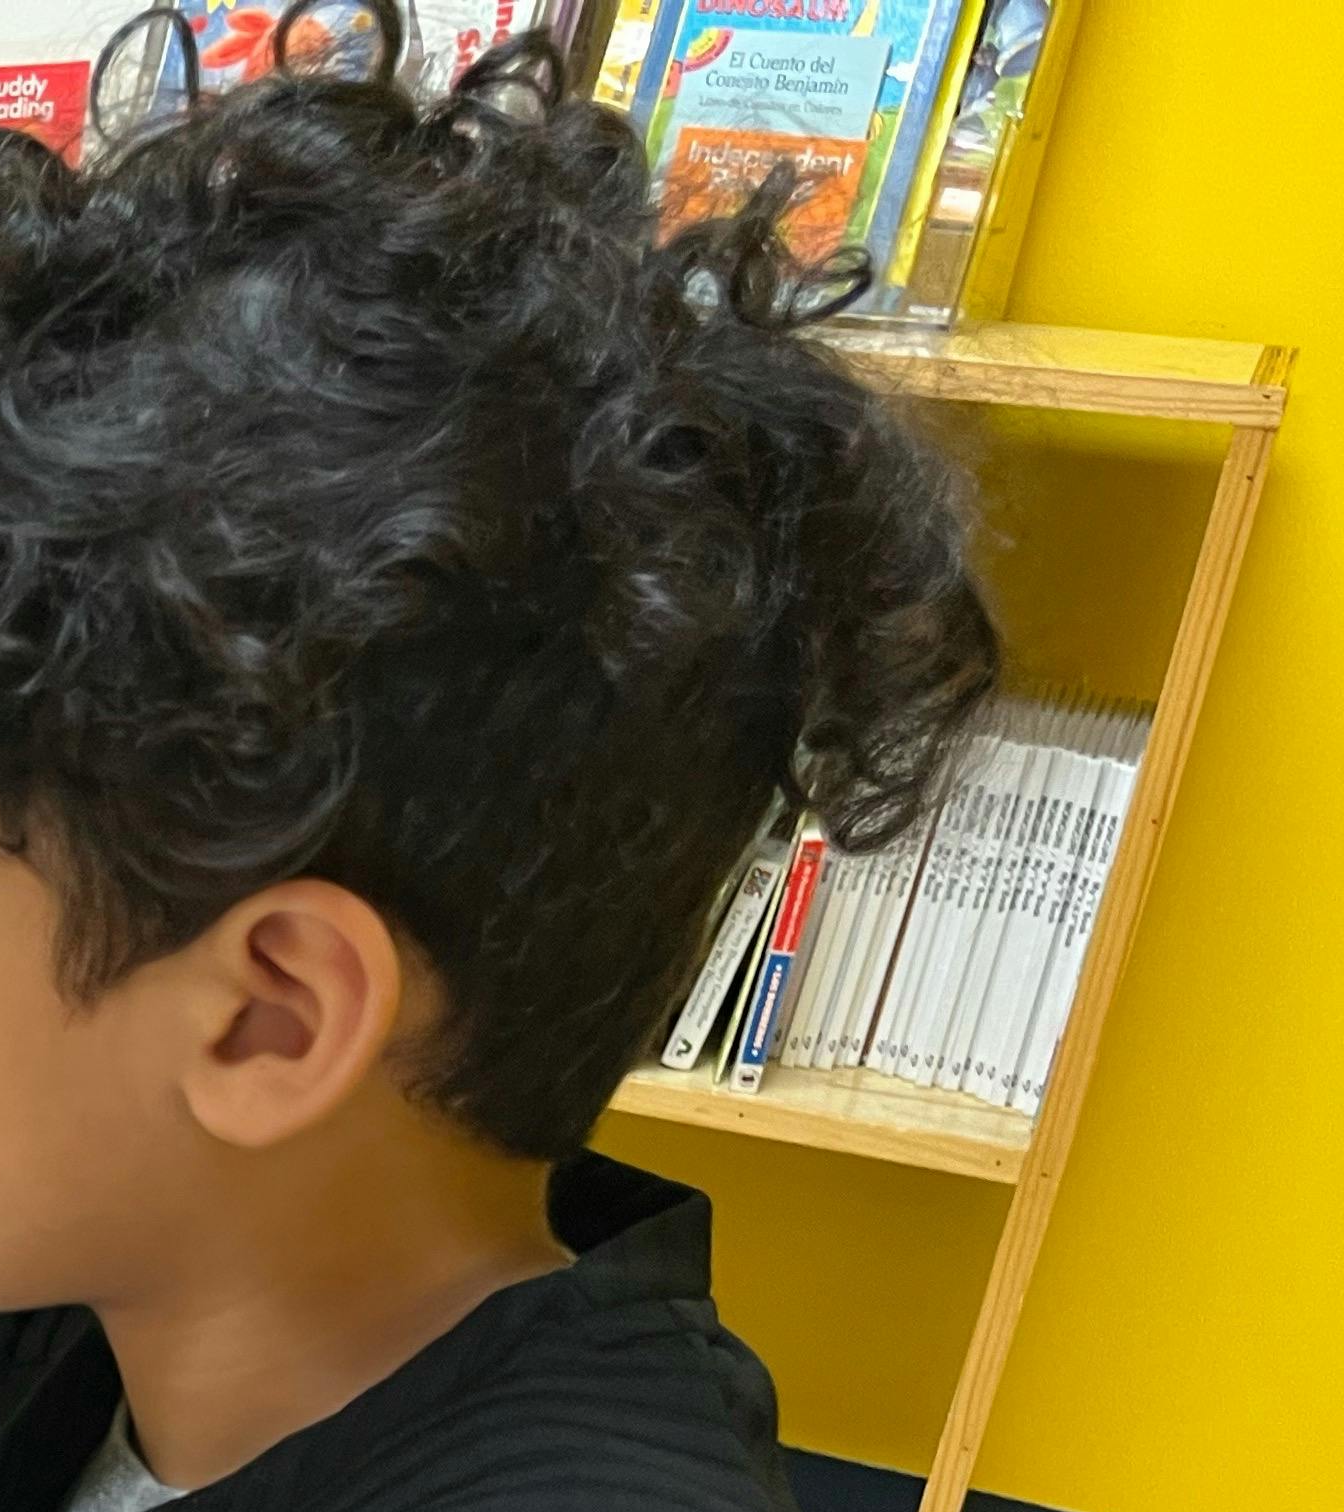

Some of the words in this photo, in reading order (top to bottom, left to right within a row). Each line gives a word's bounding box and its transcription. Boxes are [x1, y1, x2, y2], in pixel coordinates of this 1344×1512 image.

[729, 51, 744, 68] El
[749, 52, 806, 72] Cuento
[810, 56, 836, 75] del
[688, 140, 855, 176] Indepedent
